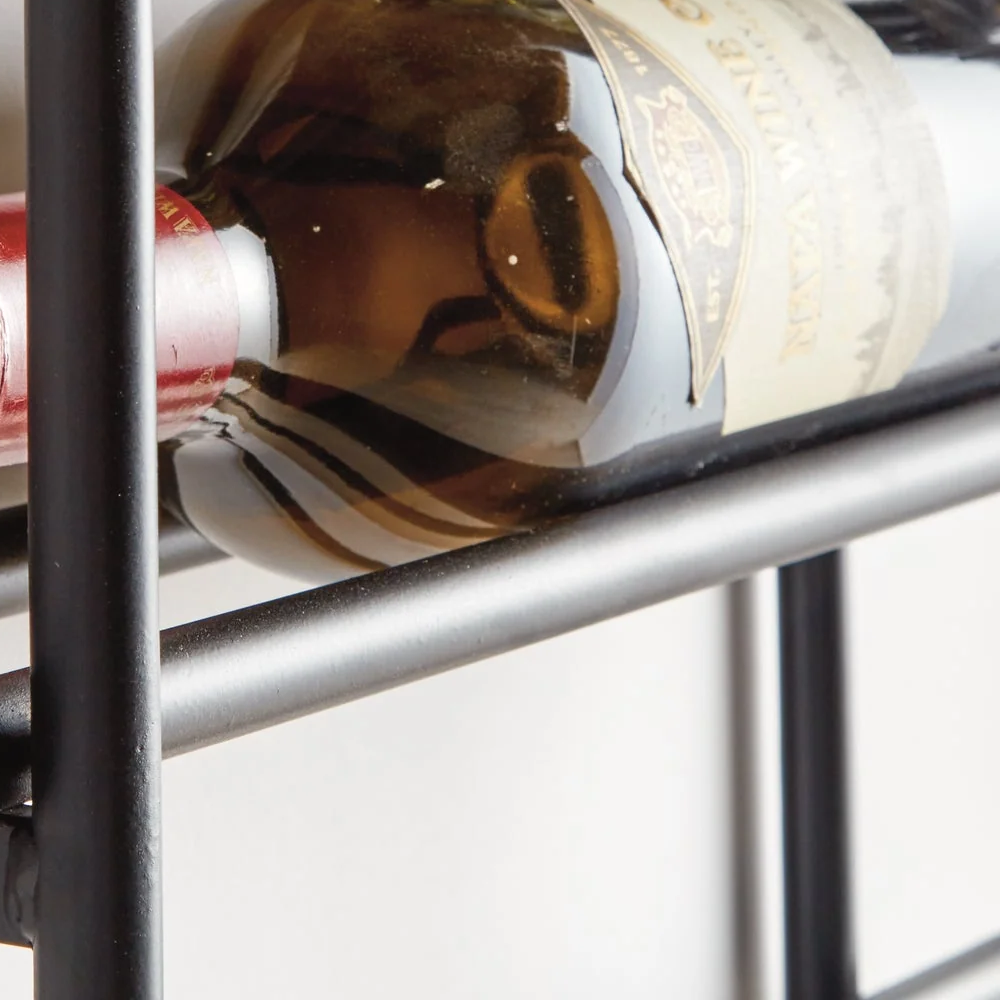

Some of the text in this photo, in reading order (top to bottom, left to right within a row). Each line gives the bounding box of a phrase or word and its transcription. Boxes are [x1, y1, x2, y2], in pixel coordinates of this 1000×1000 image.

[708, 36, 807, 182] WINE
[704, 268, 721, 323] EST.
[781, 189, 822, 362] NAPA
